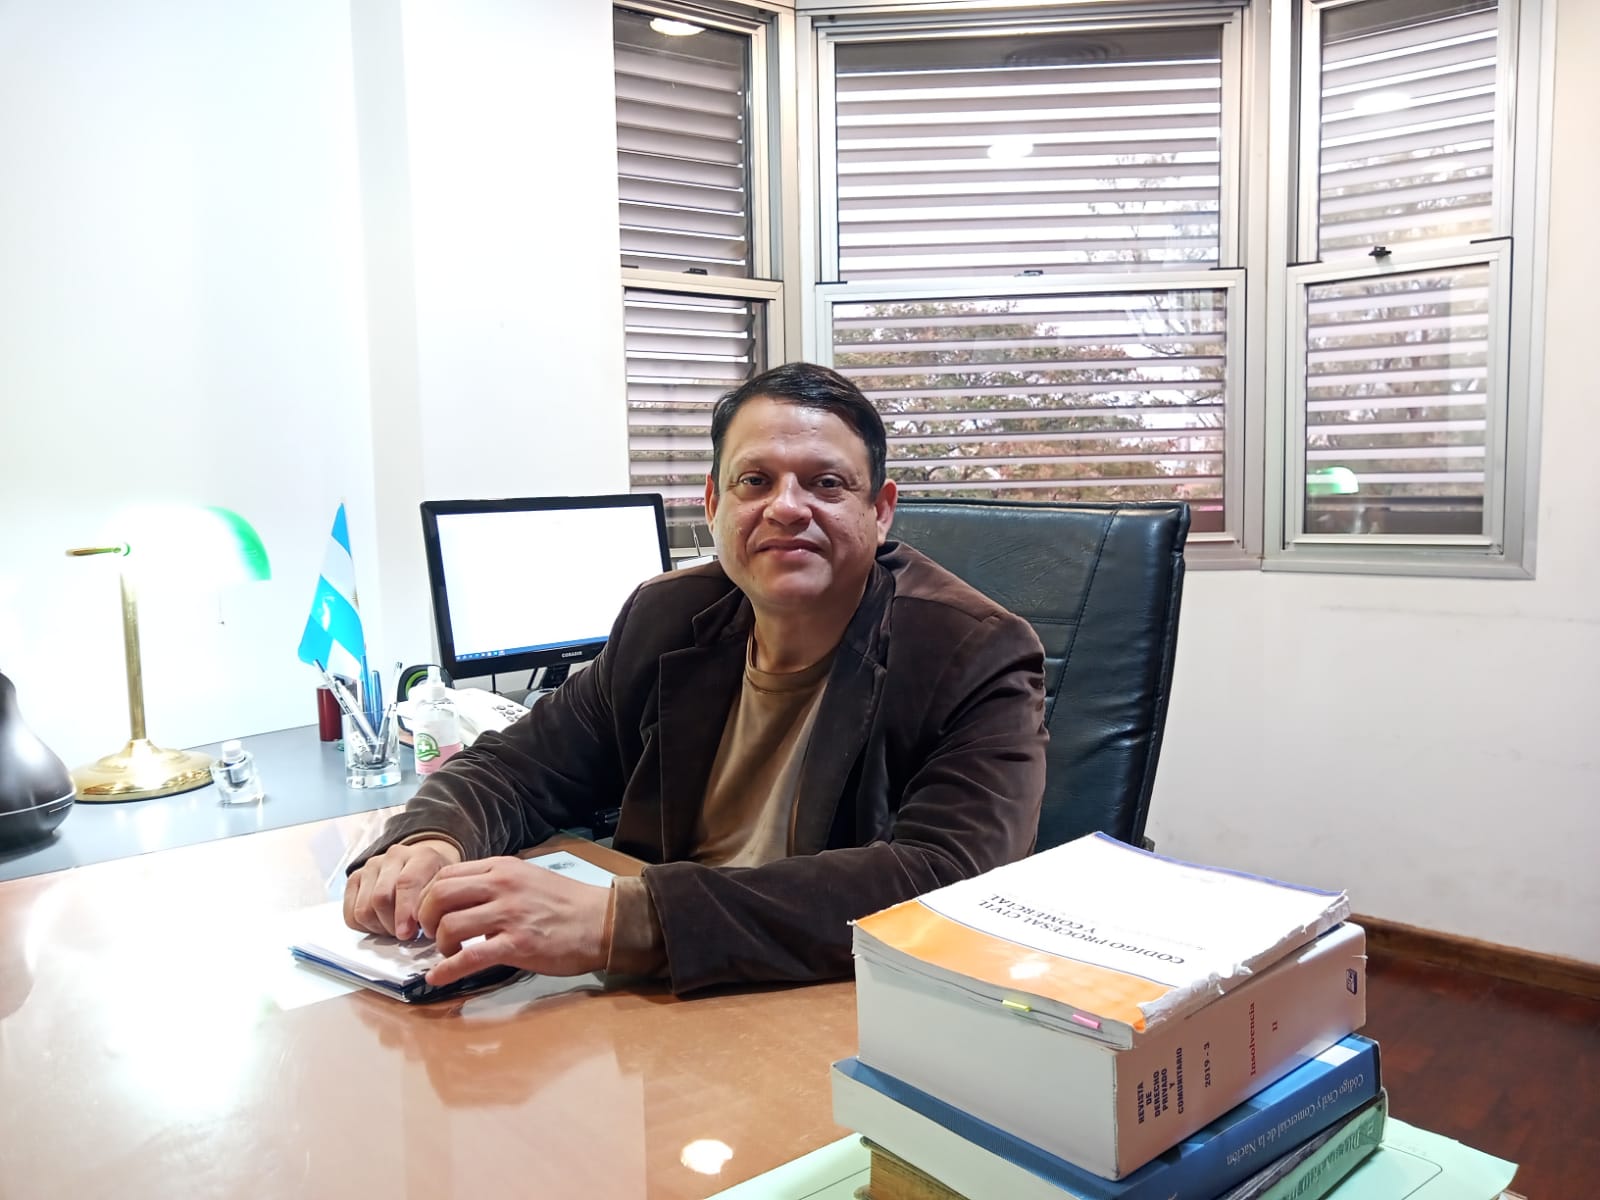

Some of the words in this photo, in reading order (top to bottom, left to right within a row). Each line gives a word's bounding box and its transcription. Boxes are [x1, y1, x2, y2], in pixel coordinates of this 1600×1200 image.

[978, 900, 1021, 919] CIVIL
[990, 895, 1083, 930] COMERCIAL
[1024, 917, 1108, 945] PROCESAL
[1109, 942, 1185, 965] CODIGO
[1176, 1047, 1184, 1114] COMUNITARIO
[1339, 1073, 1364, 1096] Código
[1137, 1081, 1145, 1125] REVISTA
[1146, 1091, 1152, 1105] DE
[1153, 1070, 1161, 1118] DERECHO
[1322, 1090, 1338, 1108] Civil
[1277, 1104, 1316, 1138] Comercial
[1258, 1136, 1265, 1149] la
[1266, 1127, 1277, 1142] de
[1226, 1141, 1257, 1166] Nación
